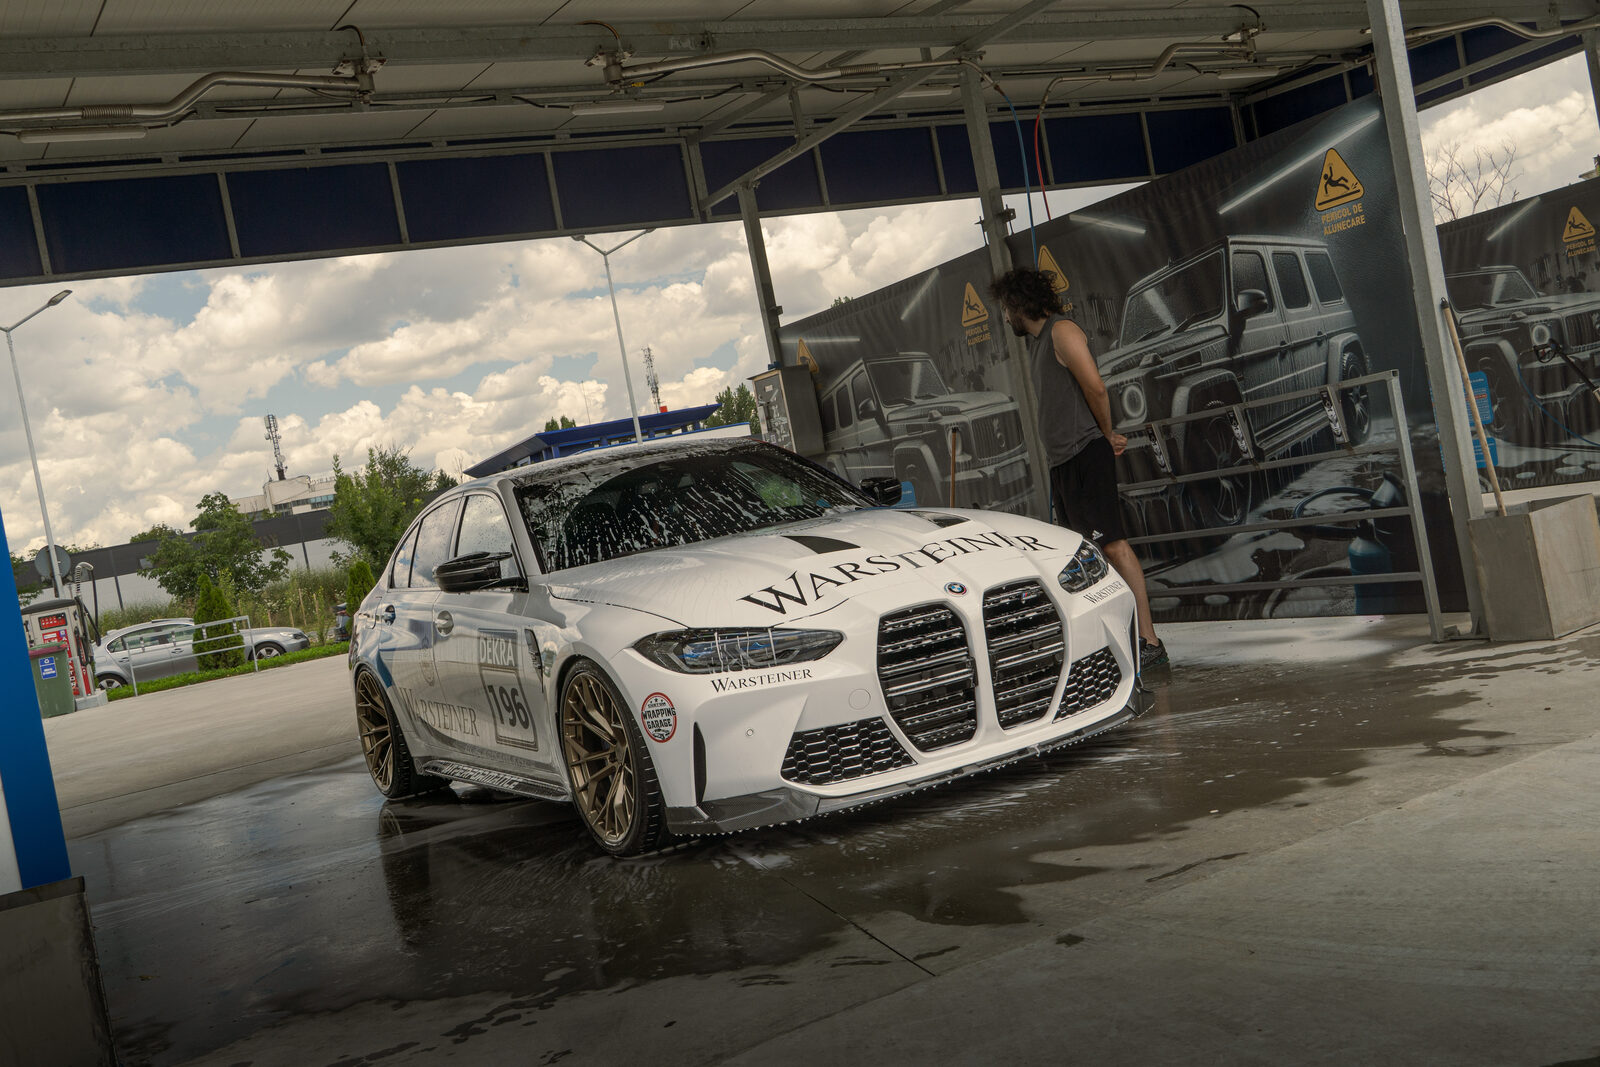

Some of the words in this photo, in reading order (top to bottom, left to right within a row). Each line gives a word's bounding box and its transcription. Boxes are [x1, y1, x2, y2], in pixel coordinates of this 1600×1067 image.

[1321, 207, 1351, 224] PERICOL
[1352, 202, 1363, 215] DE
[1324, 214, 1366, 236] ALUNECARE
[737, 531, 1058, 615] WARSTEINER
[479, 637, 515, 667] DEKRA
[487, 684, 530, 730] 196
[641, 707, 677, 720] WRAPPING
[646, 718, 673, 730] GARAGE
